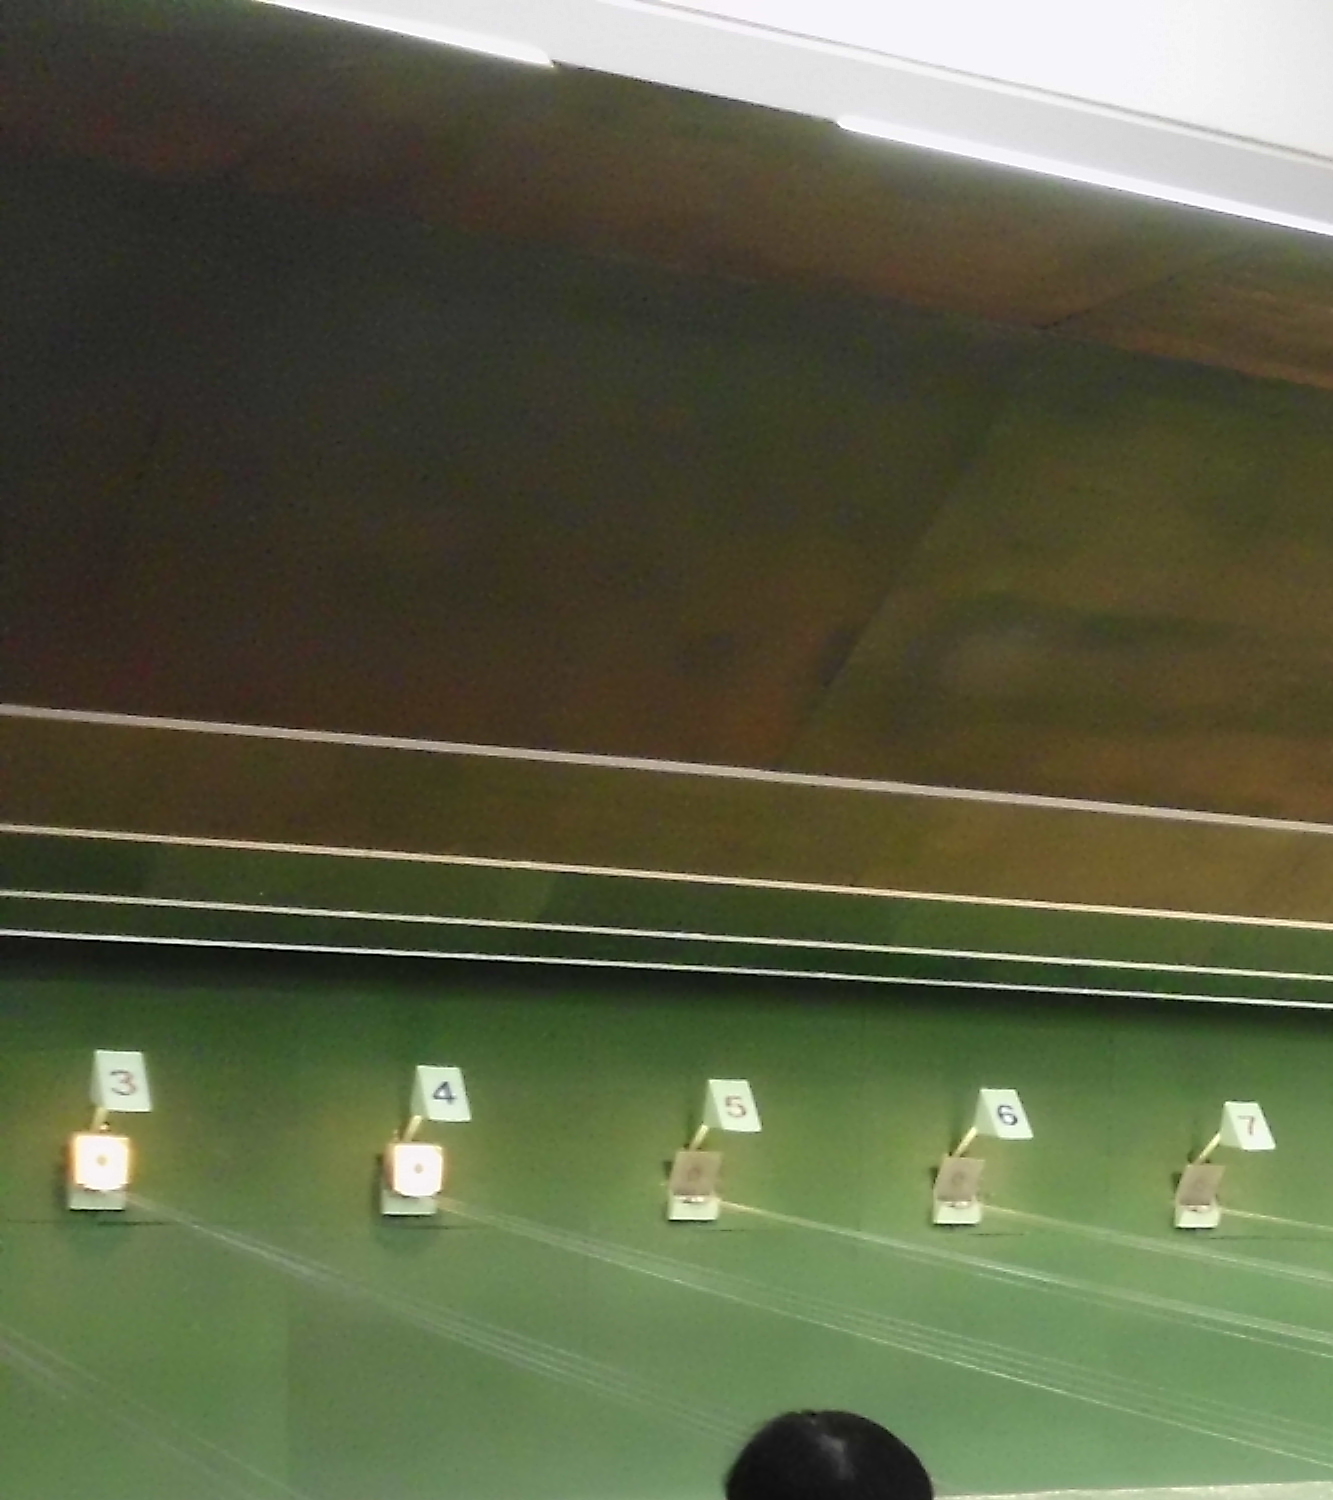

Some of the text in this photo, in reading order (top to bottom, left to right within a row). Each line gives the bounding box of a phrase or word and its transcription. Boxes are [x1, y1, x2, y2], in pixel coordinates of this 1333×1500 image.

[109, 1068, 138, 1096] 3
[432, 1080, 458, 1106] 4
[724, 1094, 747, 1119] 5
[996, 1104, 1019, 1127] 6
[1236, 1114, 1256, 1136] 7
